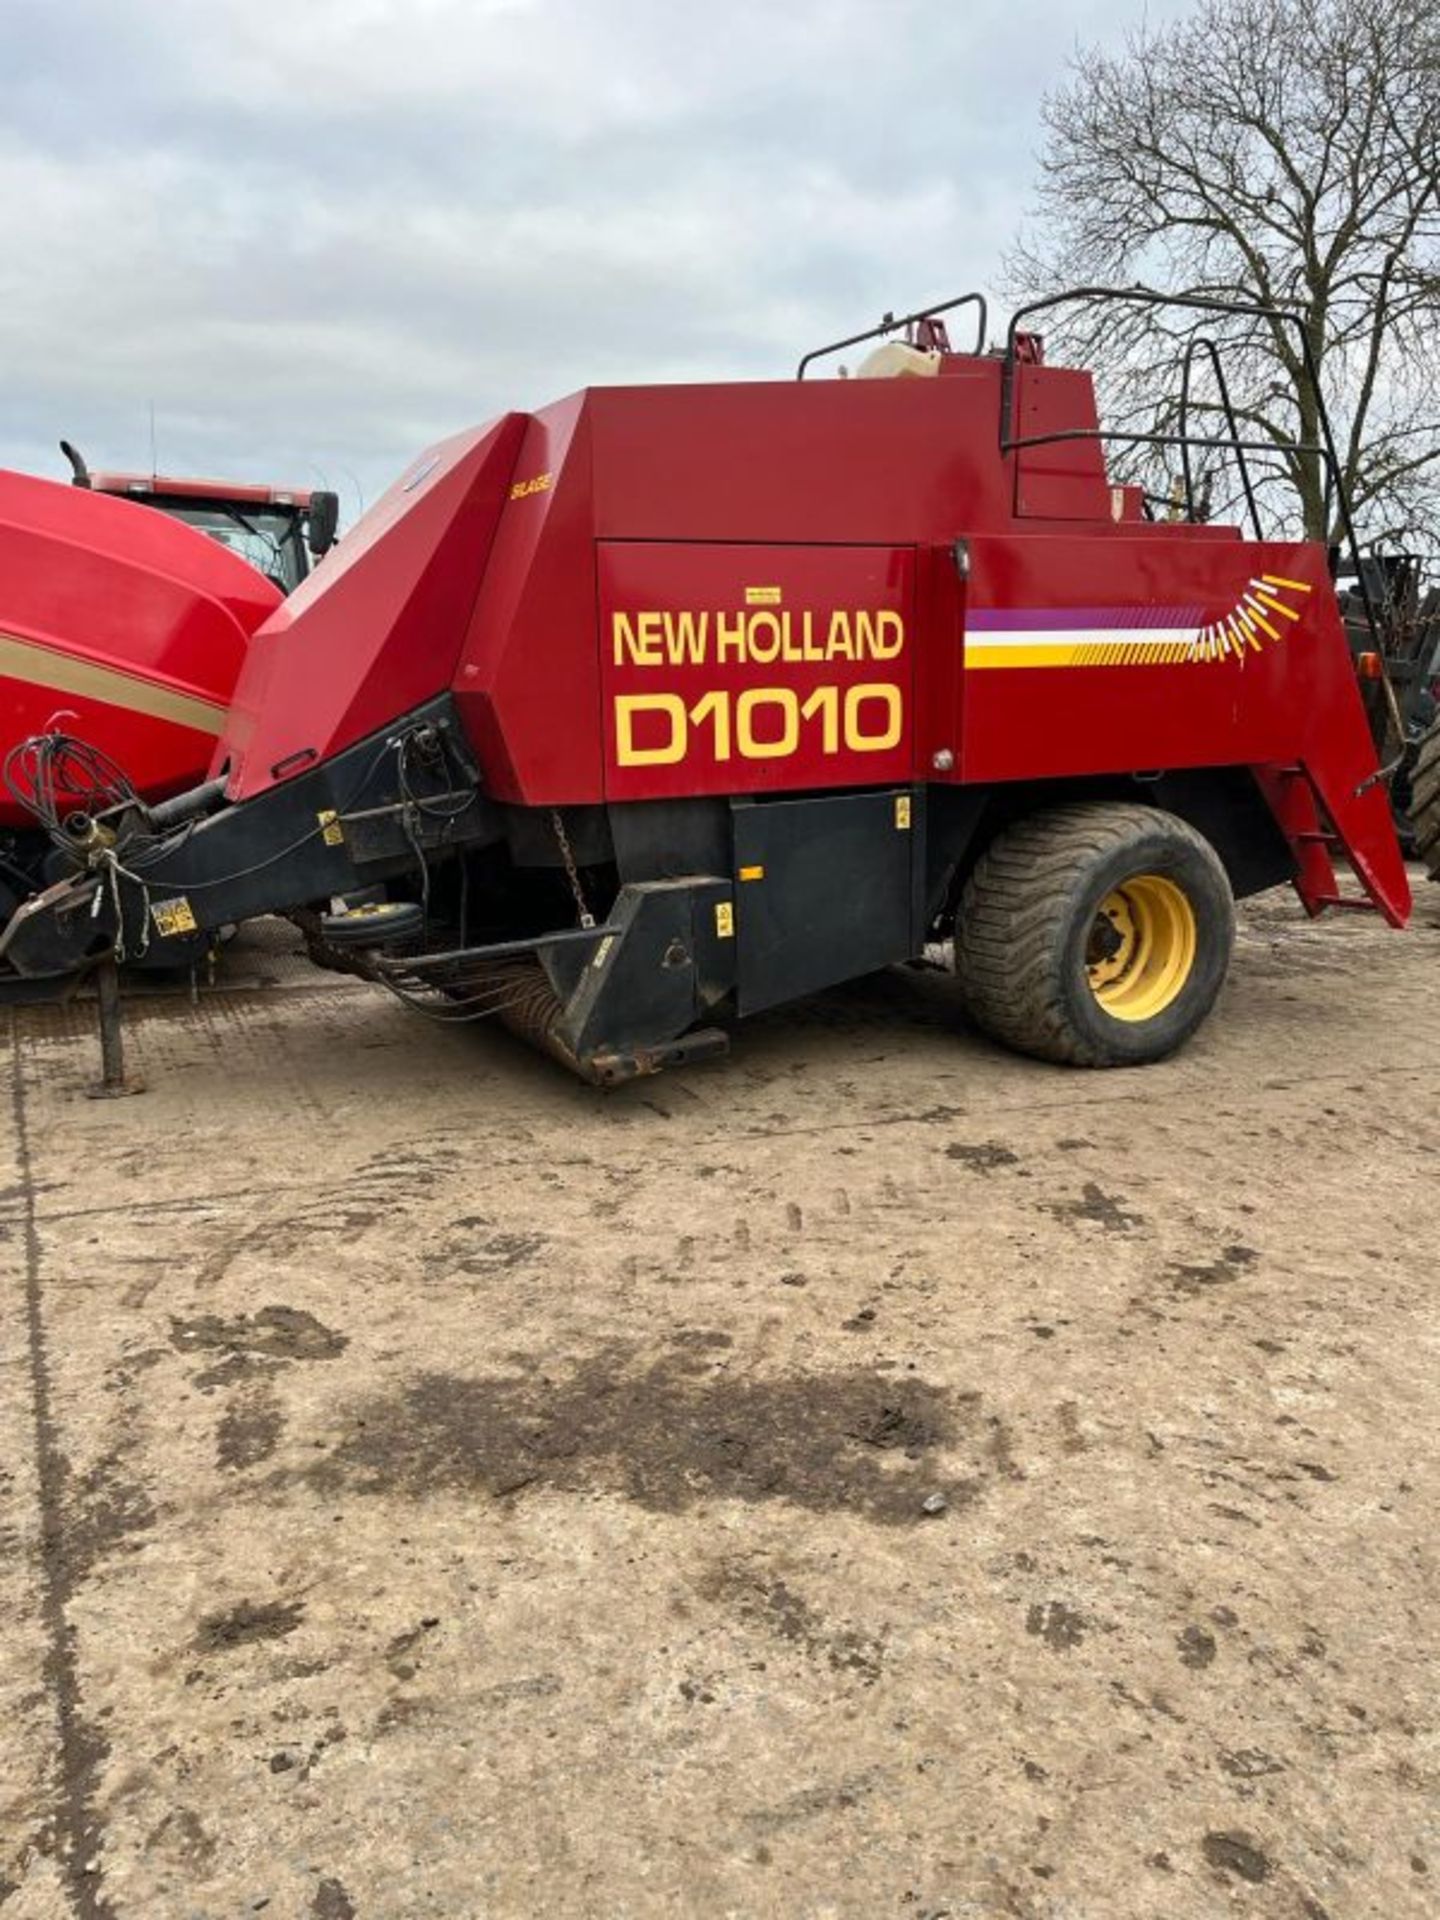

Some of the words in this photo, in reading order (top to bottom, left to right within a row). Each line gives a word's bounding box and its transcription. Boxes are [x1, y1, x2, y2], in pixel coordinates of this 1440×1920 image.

[613, 611, 709, 666] NEW
[716, 610, 904, 663] HOLLAND
[614, 683, 902, 767] D1010
